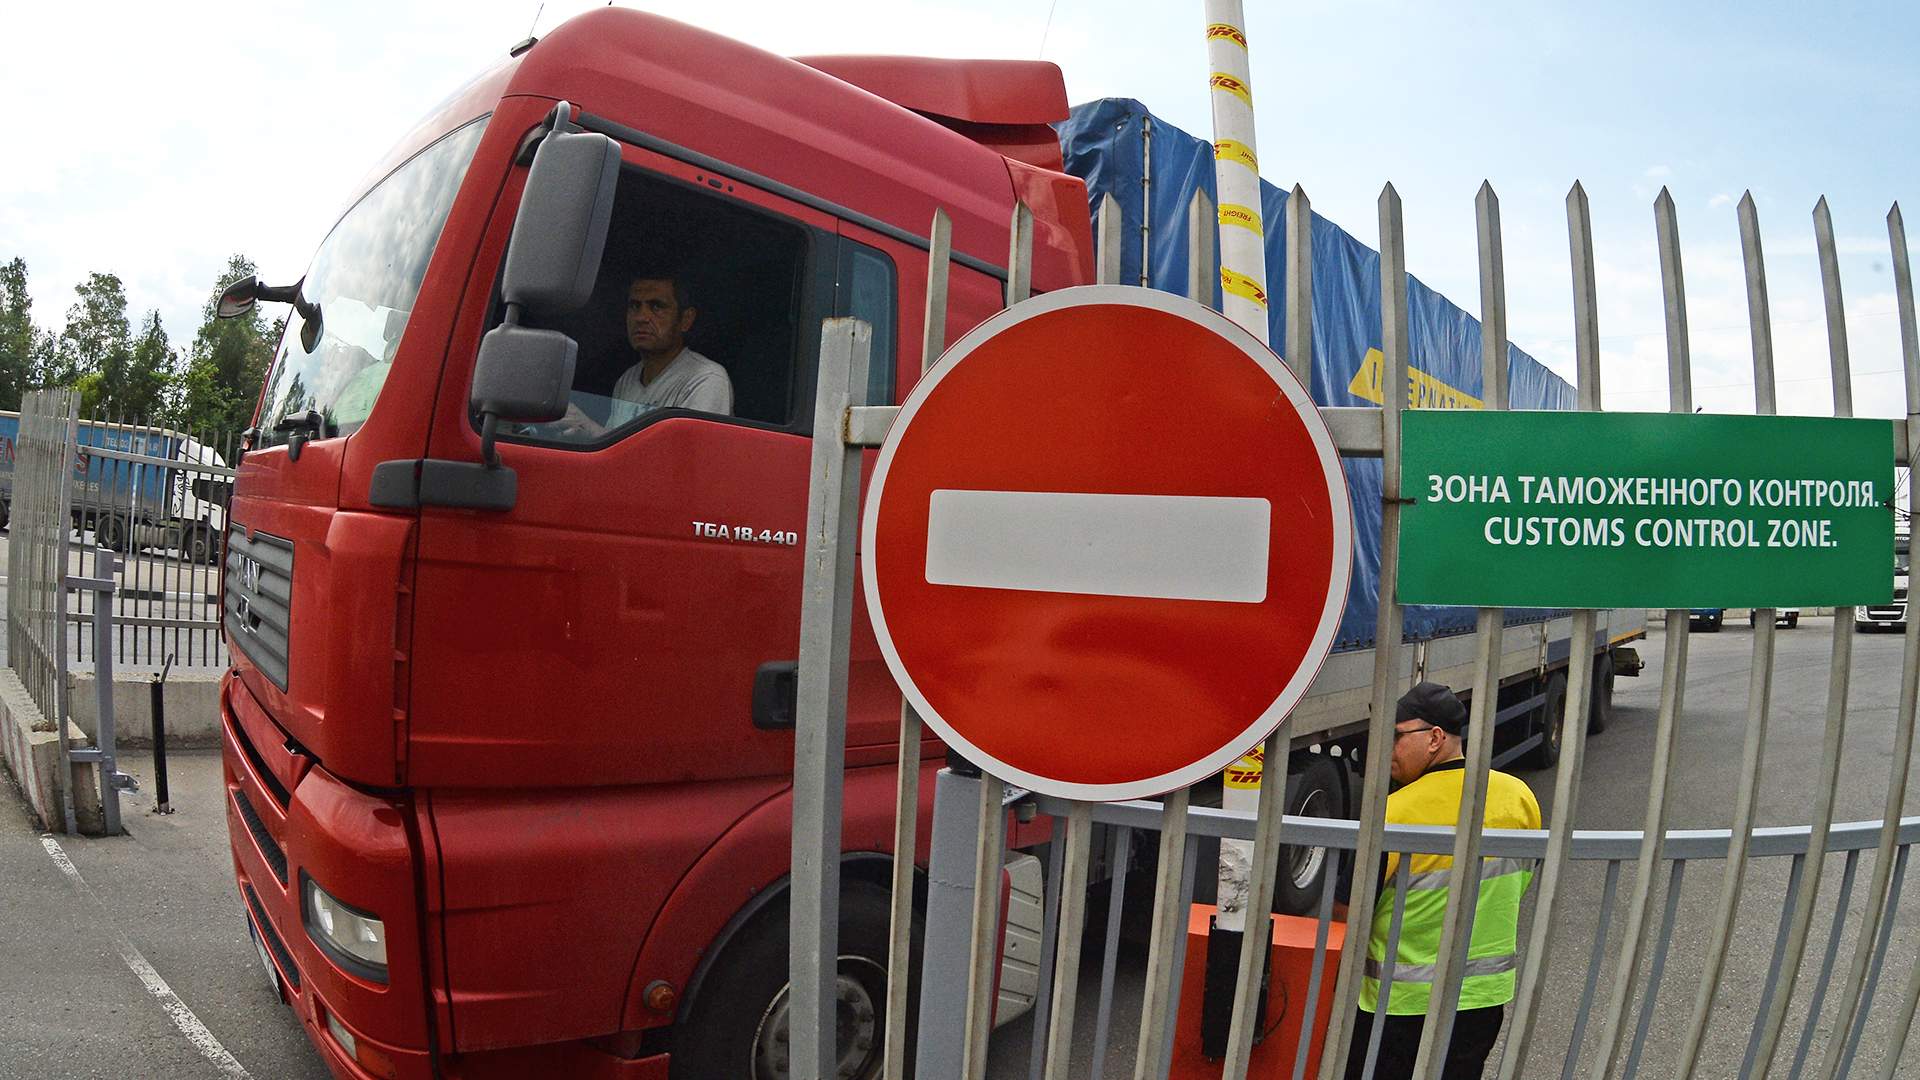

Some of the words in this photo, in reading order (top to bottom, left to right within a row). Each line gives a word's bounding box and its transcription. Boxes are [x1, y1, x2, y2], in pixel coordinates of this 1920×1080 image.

[1223, 210, 1252, 222] FREIGHT
[1427, 474, 1511, 504] ЗОНА
[1518, 476, 1742, 507] ТАМОЖЕННОГО
[1749, 479, 1879, 508] КОНТРОЛЯ.
[692, 521, 729, 539] TGA
[733, 526, 798, 546] 18.440
[1484, 516, 1625, 547] CUSTOMS
[1635, 518, 1760, 548] CONTROL
[1767, 519, 1837, 548] ZONE.
